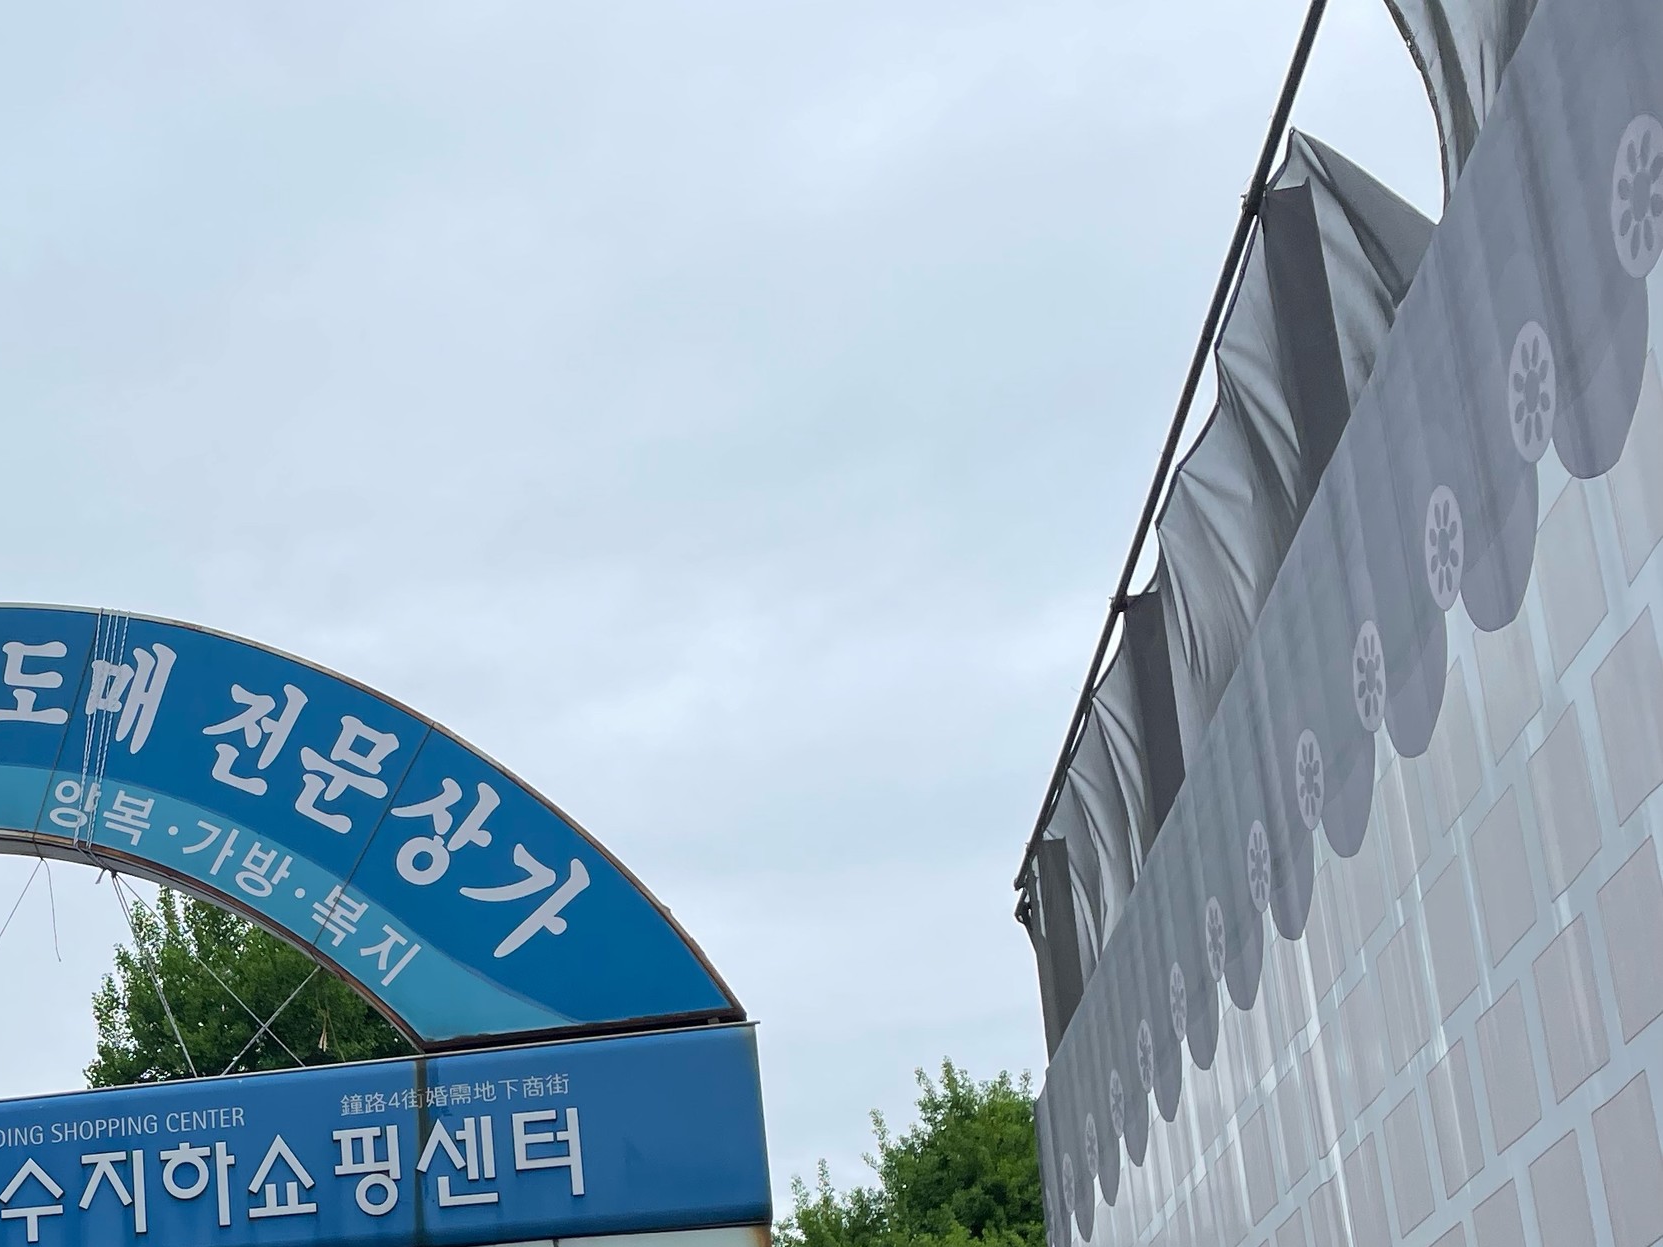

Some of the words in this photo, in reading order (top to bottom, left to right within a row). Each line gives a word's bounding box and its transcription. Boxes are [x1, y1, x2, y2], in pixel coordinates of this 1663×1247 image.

[203, 683, 591, 959] 전문상가
[51, 1115, 158, 1143] SHOPPING
[165, 1107, 245, 1133] CENTER
